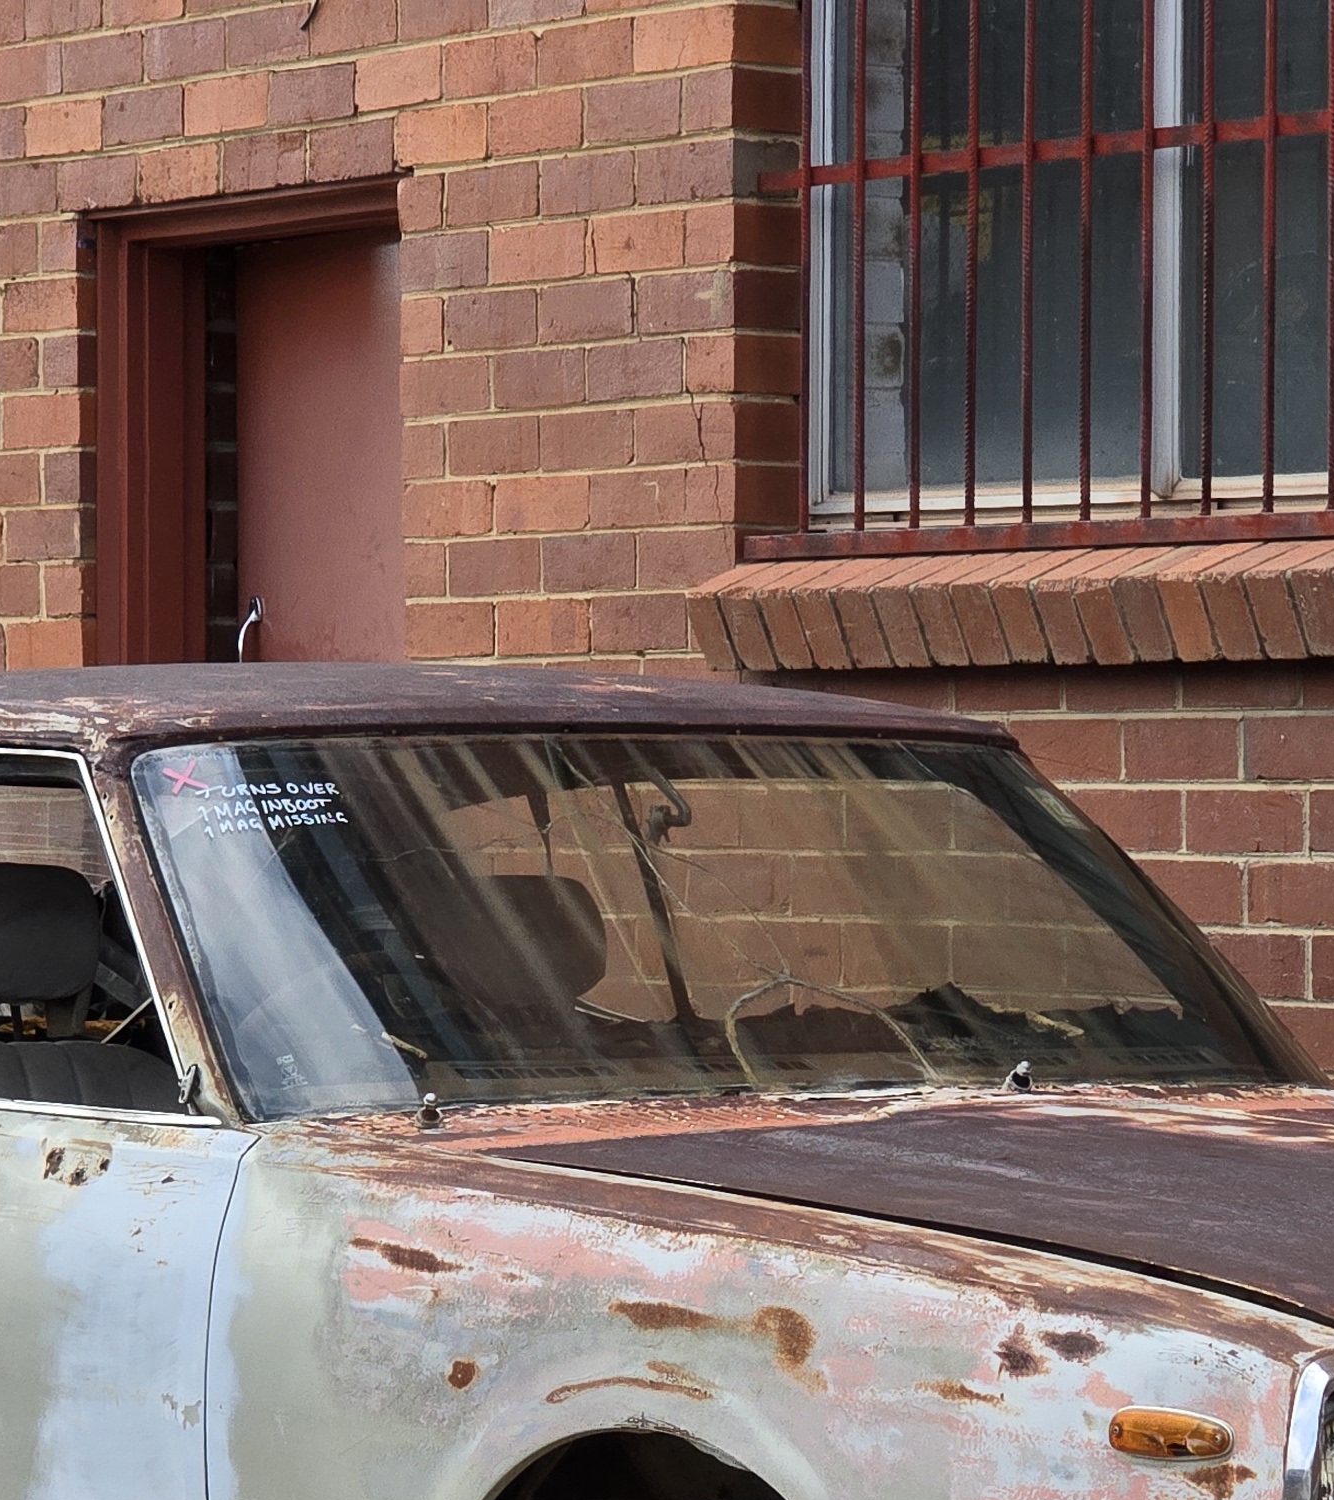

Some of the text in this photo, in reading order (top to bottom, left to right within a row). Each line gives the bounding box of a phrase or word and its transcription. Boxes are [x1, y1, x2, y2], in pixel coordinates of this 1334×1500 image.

[195, 782, 340, 798] TURNS OVER
[197, 805, 209, 822] 1
[214, 799, 260, 820] MAG
[203, 811, 349, 838] 1 MAG MISSING
